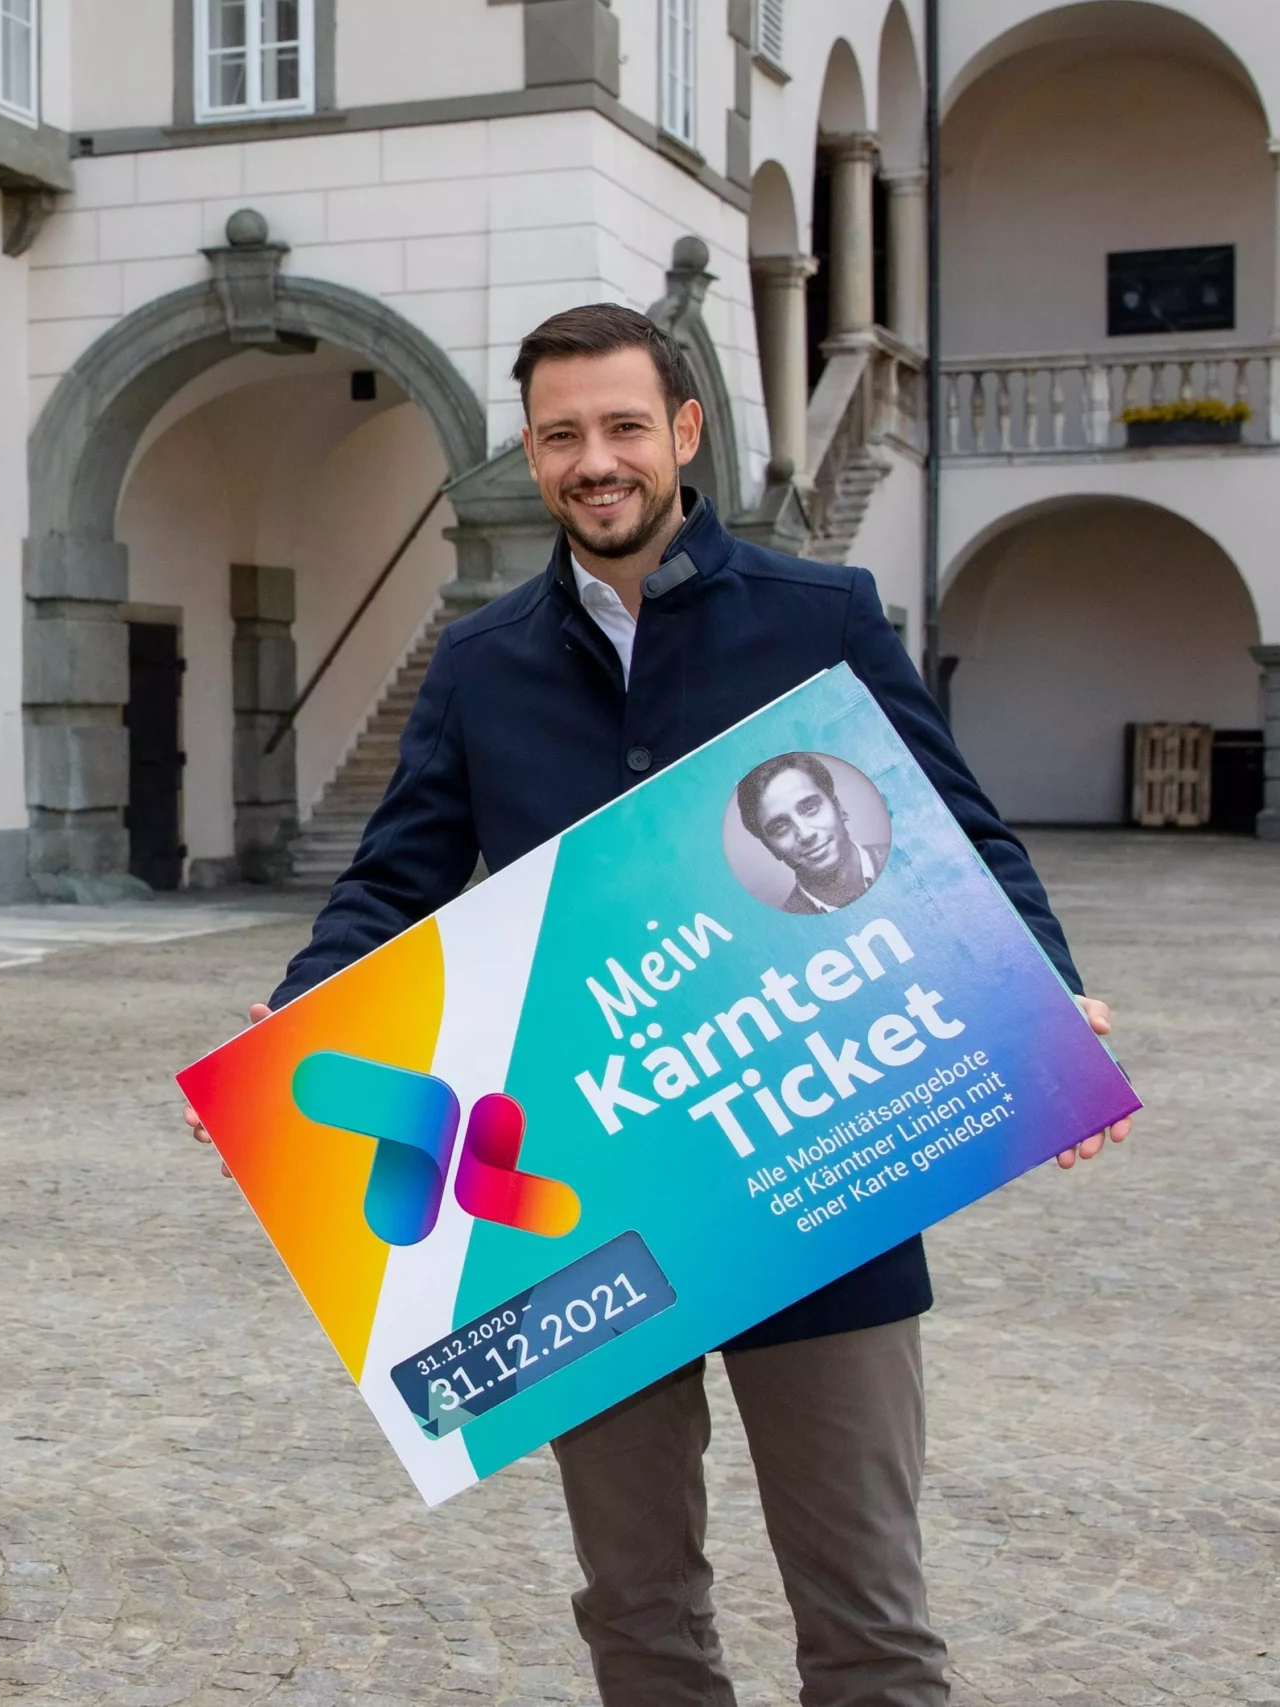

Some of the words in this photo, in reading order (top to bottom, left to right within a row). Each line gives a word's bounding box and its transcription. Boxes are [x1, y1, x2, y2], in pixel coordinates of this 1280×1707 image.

[574, 918, 914, 1135] Kärnten
[586, 912, 733, 1040] Mein
[687, 983, 966, 1158] Ticket
[747, 1166, 787, 1198] Alle
[786, 1050, 989, 1172] Mobilitätsangebote
[770, 1187, 803, 1215] der
[805, 1134, 897, 1195] Kärntner
[896, 1096, 965, 1142] Linien
[966, 1071, 1005, 1104] mit
[797, 1195, 848, 1233] einer
[848, 1161, 909, 1202] Karte
[417, 1310, 517, 1376] 31.12.2020
[431, 1273, 647, 1412] 31.12.2021
